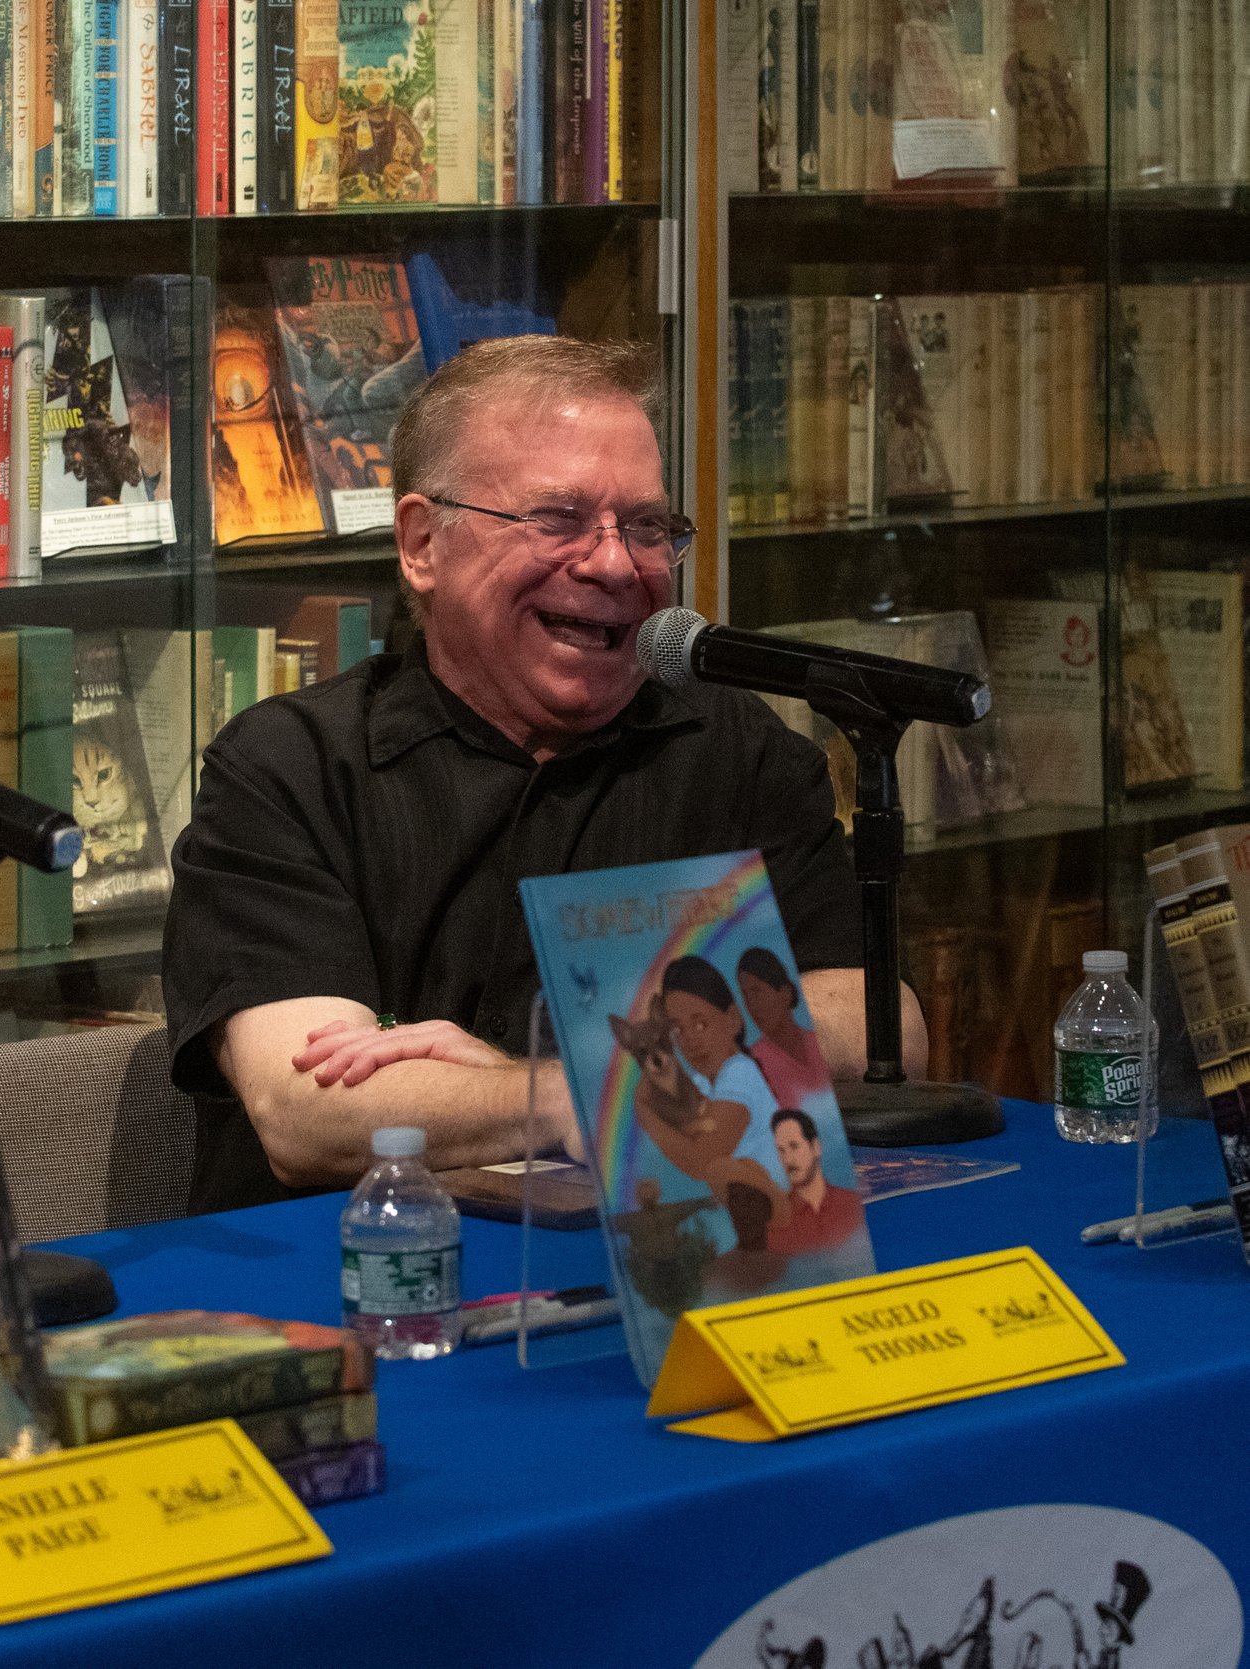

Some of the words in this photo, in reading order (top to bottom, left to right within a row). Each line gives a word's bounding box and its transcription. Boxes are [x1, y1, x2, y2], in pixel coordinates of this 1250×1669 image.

[83, 20, 93, 77] Outlaws
[98, 46, 111, 73] FOR
[45, 54, 54, 97] PRICE
[83, 79, 92, 92] of
[97, 78, 111, 139] CHARLIE
[83, 95, 93, 164] Sherwood
[97, 145, 111, 182] BONE
[27, 388, 42, 470] LIGHTNING
[27, 476, 42, 513] THIEF
[81, 683, 122, 698] SQUARE
[841, 1300, 942, 1339] ANGELO
[855, 1327, 968, 1368] THOMAS
[6, 1518, 109, 1561] PAIGE
